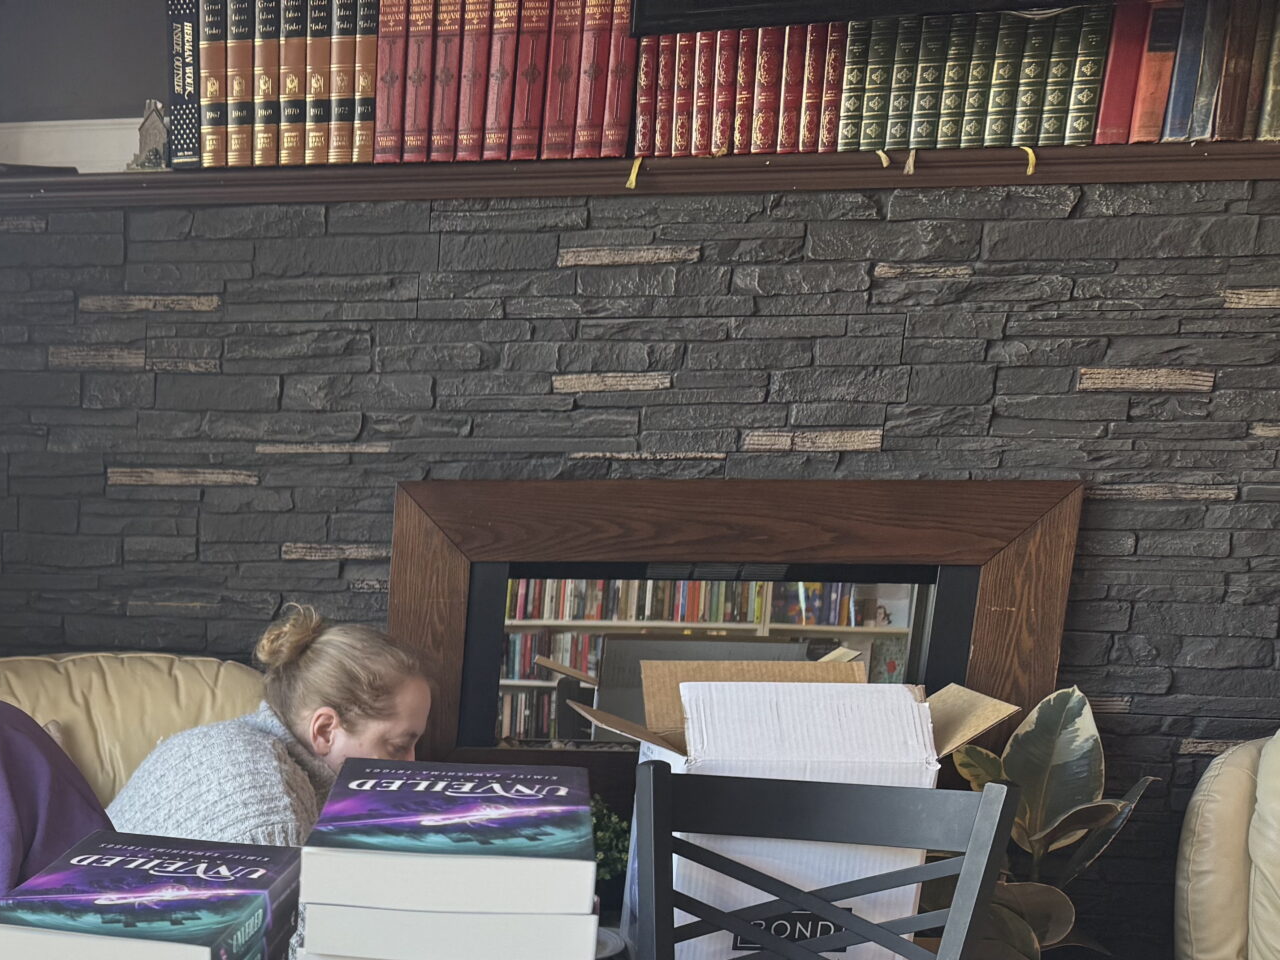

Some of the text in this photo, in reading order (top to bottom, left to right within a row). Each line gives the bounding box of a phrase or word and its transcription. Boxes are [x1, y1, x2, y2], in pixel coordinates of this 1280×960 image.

[258, 0, 276, 8] Great
[260, 12, 274, 20] Ideas
[286, 10, 301, 18] Ideas
[312, 10, 327, 18] Ideas
[337, 8, 352, 16] Ideas
[360, 8, 375, 16] Ideas
[205, 14, 221, 22] Ideas
[232, 13, 247, 21] Ideas
[183, 22, 193, 63] HERMAN
[174, 56, 183, 94] OUTSIDE
[348, 779, 569, 799] UNVEILED
[70, 854, 268, 882] UNVEILED
